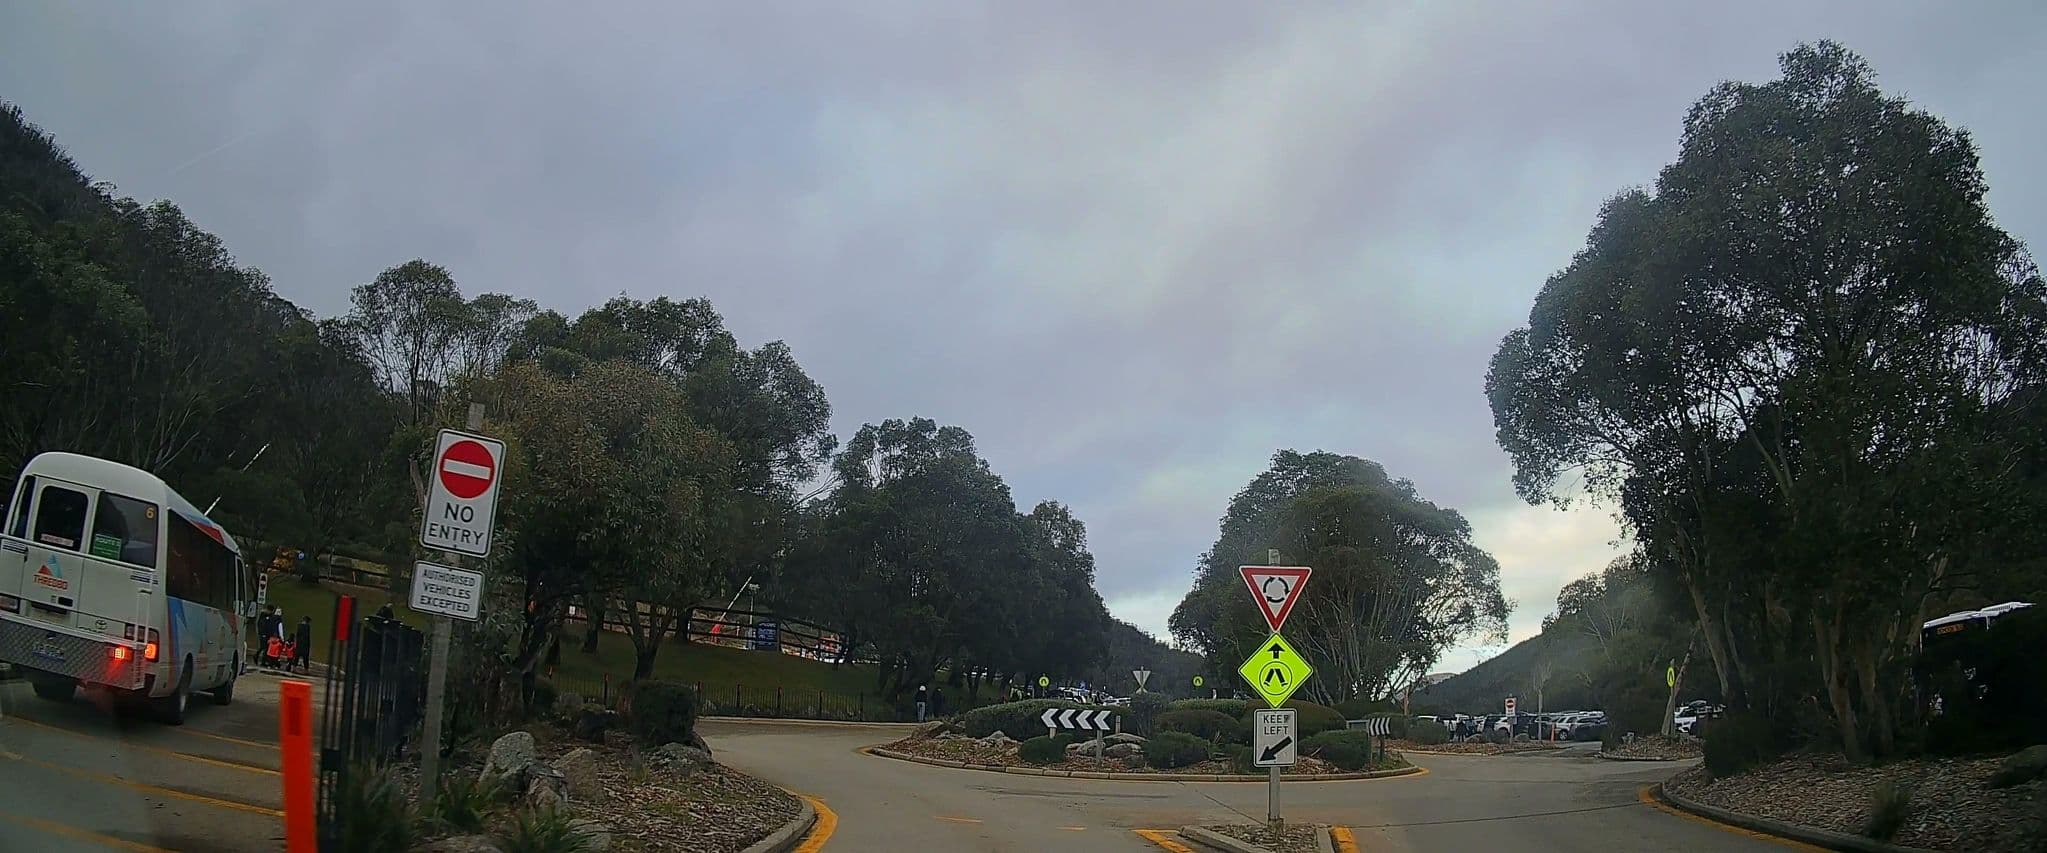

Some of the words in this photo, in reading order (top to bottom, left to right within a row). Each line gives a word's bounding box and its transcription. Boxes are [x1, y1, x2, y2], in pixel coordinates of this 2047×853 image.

[146, 507, 155, 519] 6
[444, 502, 474, 523] NO
[428, 523, 484, 545] ENTRY
[423, 569, 476, 587] AUTHORISED
[423, 582, 471, 600] VEHICLES
[420, 595, 470, 613] EXCEPTED
[1263, 714, 1290, 724] KEEP
[1264, 725, 1289, 735] LEFT
